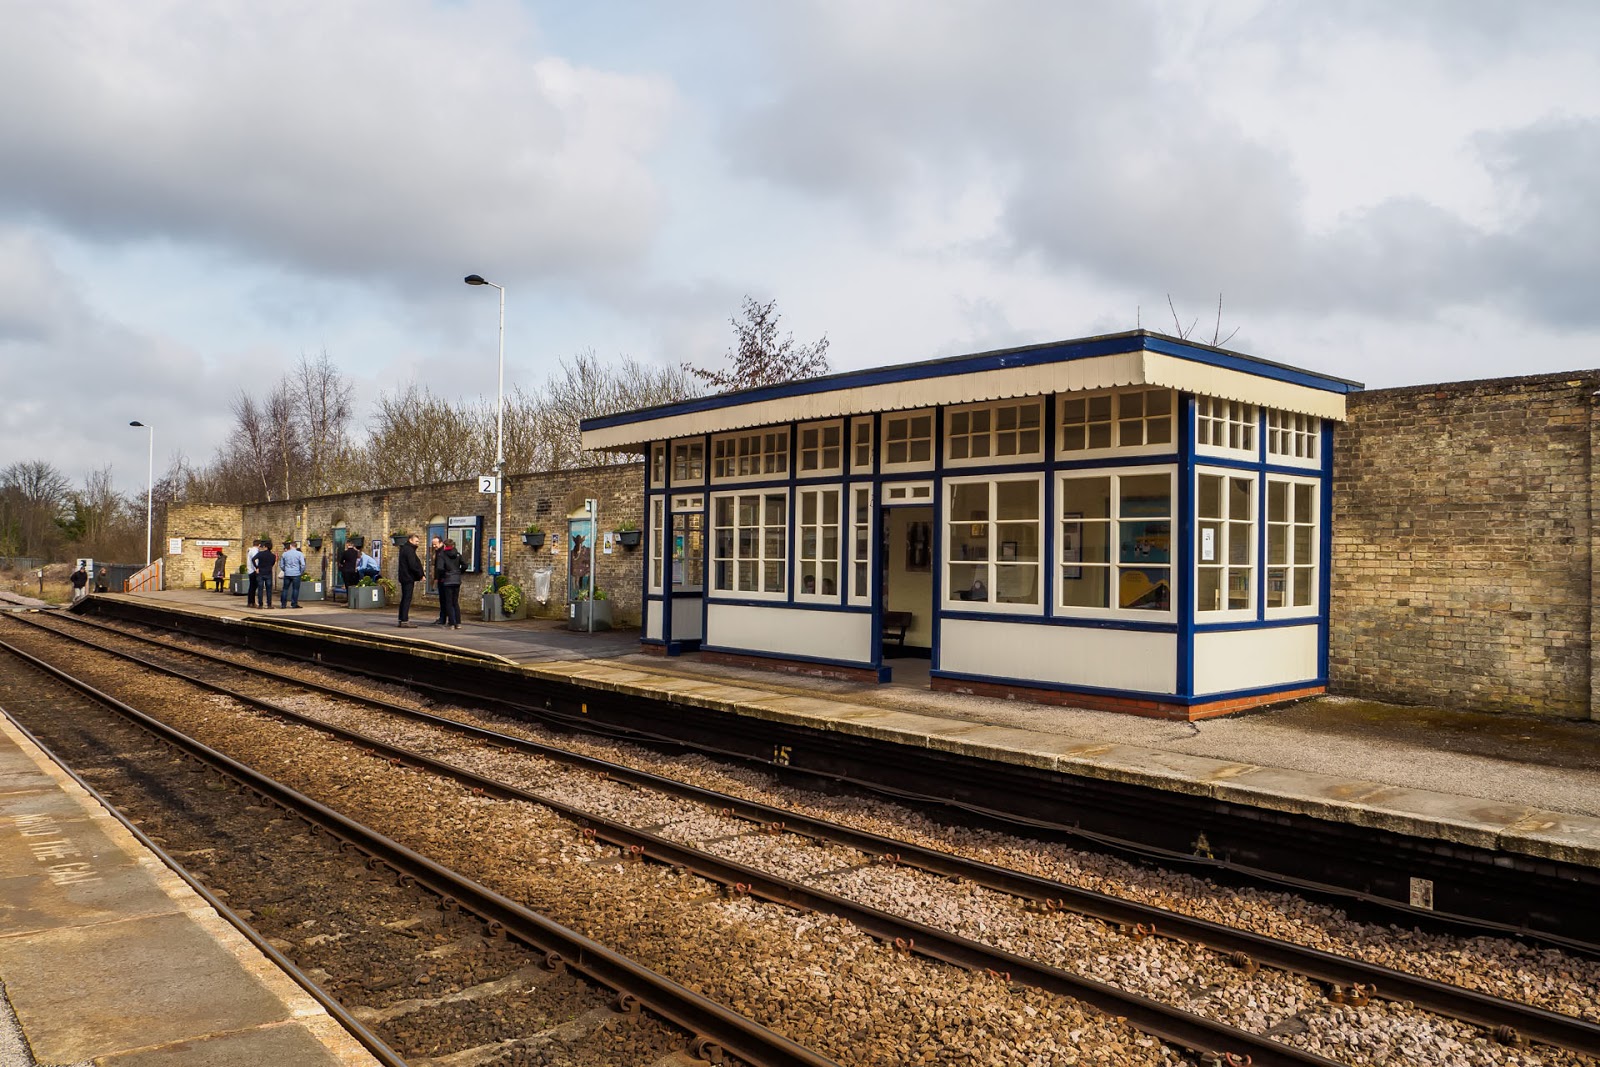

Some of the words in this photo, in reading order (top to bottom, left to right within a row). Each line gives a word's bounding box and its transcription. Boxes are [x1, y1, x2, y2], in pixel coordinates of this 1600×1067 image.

[483, 479, 491, 492] 2
[774, 744, 792, 766] 15
[28, 838, 82, 861] THE
